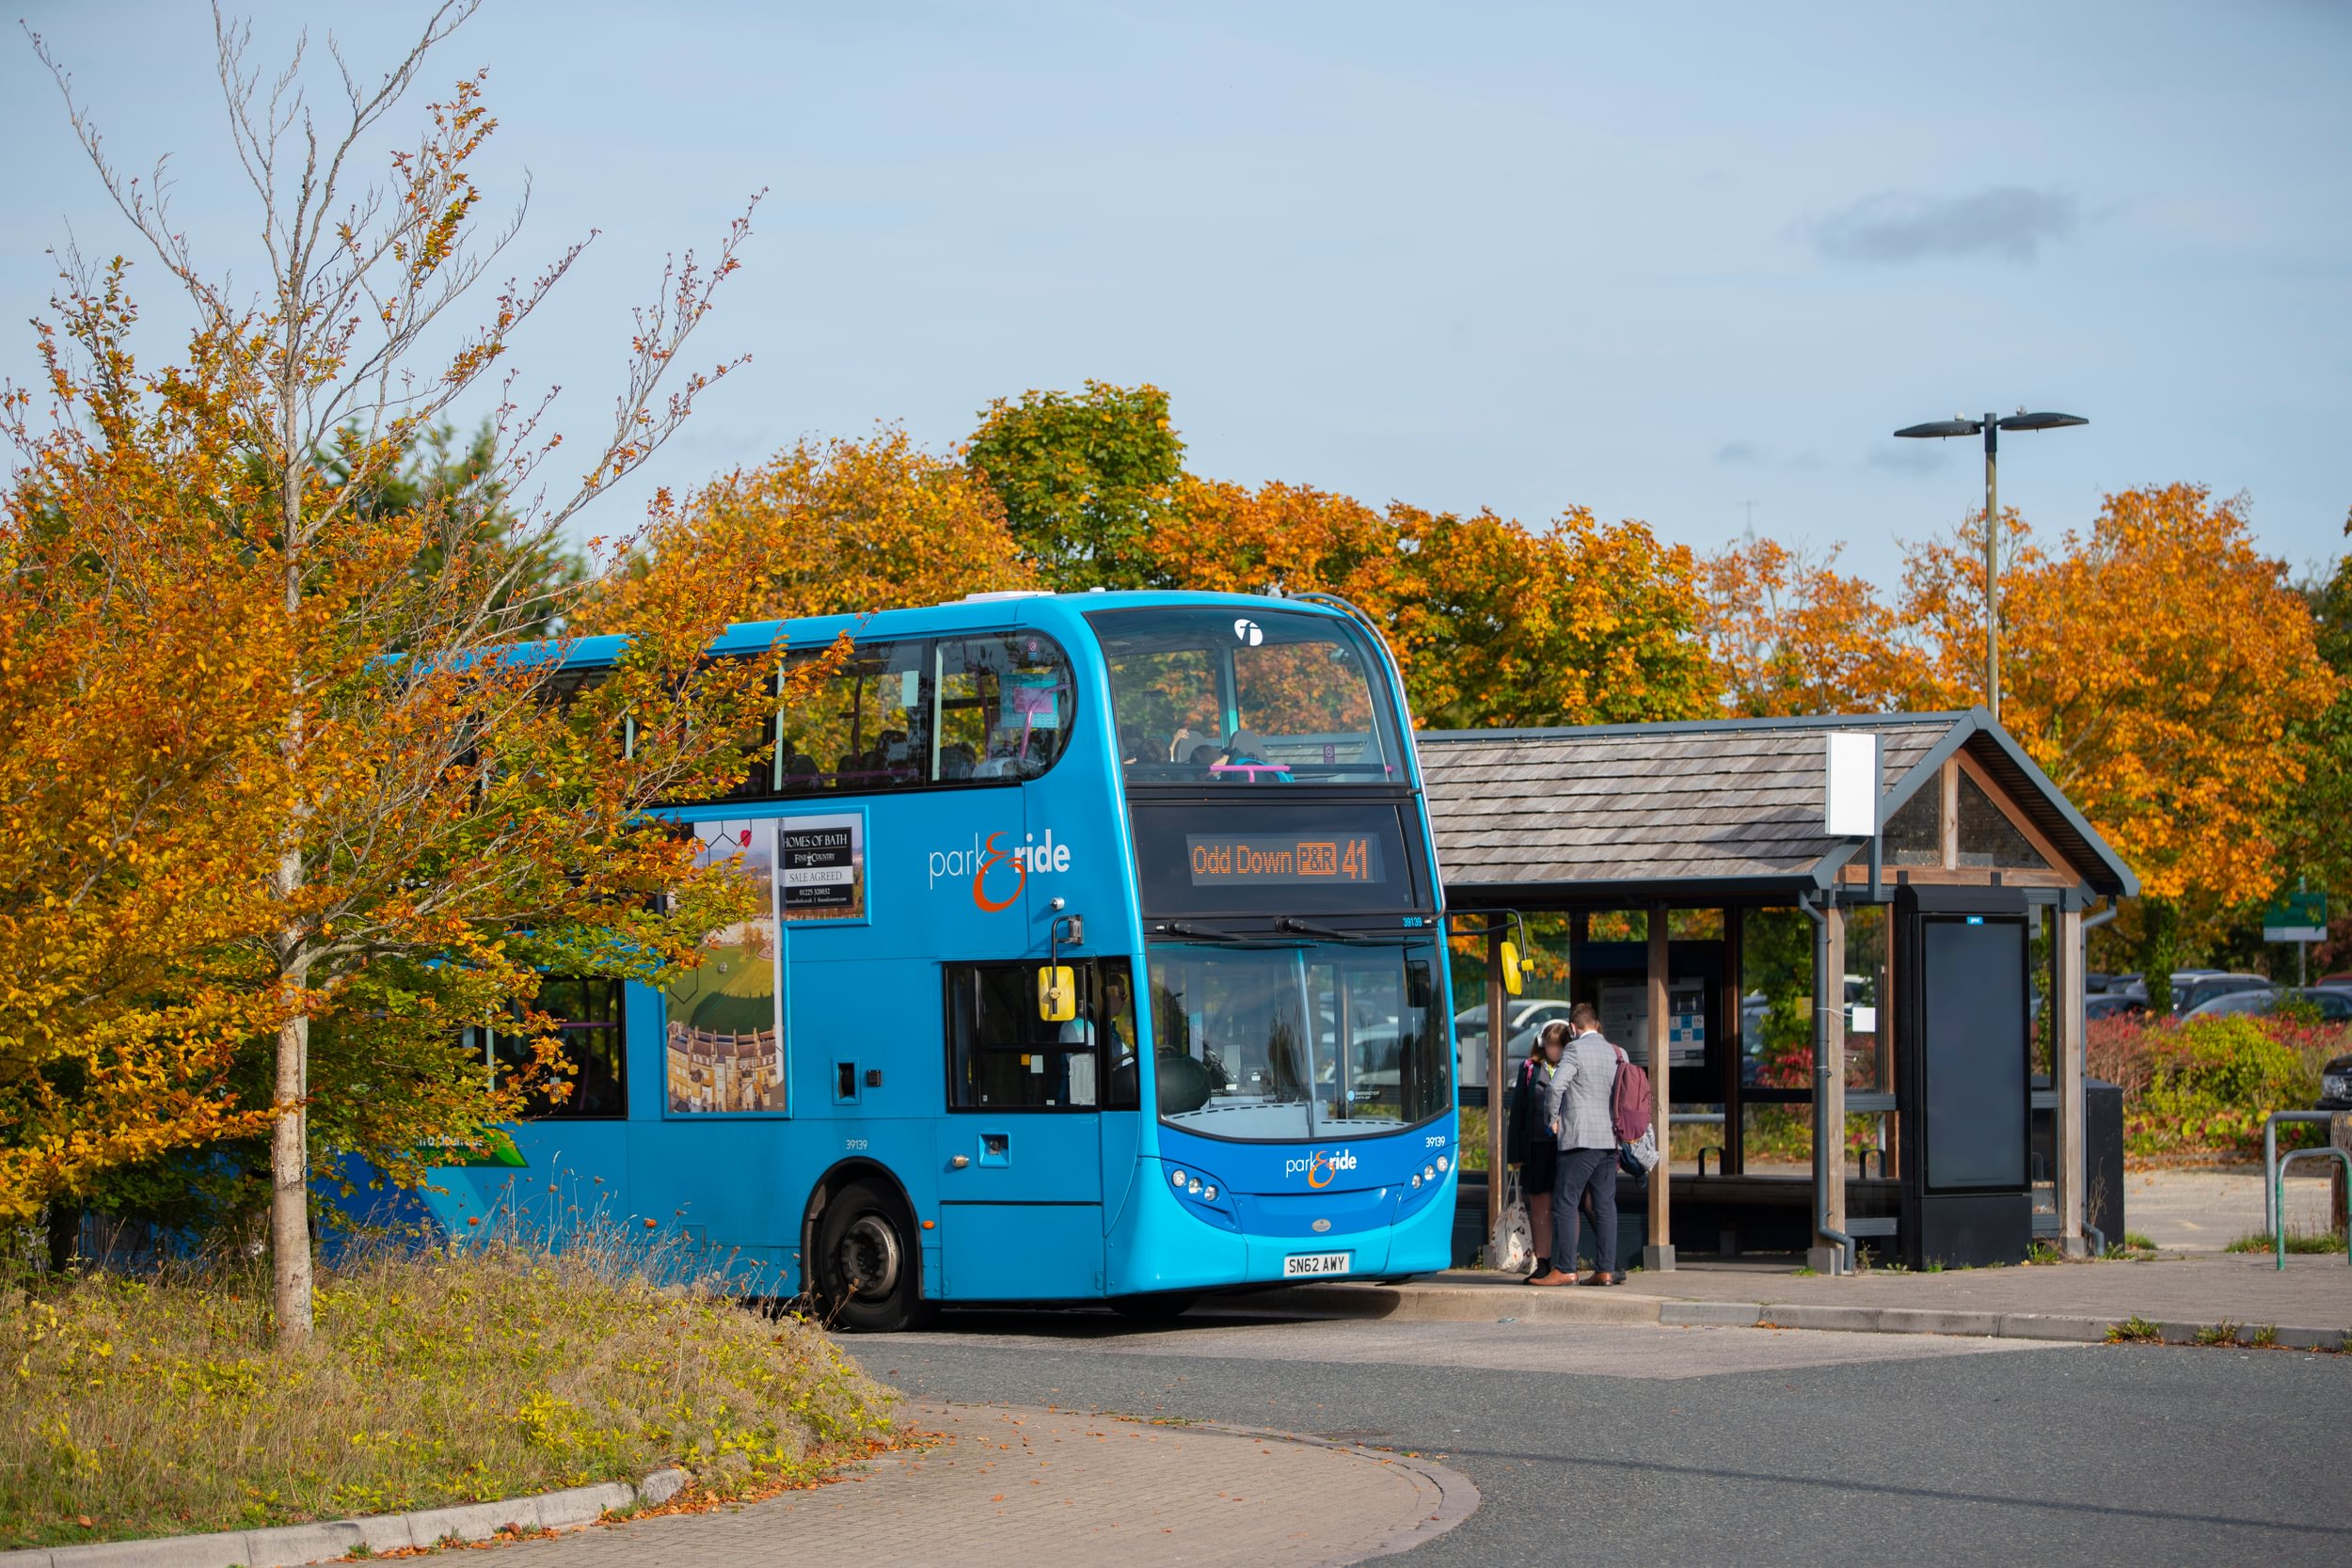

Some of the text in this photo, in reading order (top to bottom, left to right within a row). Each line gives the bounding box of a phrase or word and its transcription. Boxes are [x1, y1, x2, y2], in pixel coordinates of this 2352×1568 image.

[785, 833, 848, 847] HOMES OF BATH
[929, 832, 989, 891] park
[1013, 829, 1071, 874] ride
[1192, 840, 1368, 880] Odd Down P&R 41
[789, 871, 842, 882] SALE AGREED
[1402, 916, 1422, 927] 39139
[846, 1139, 868, 1149] 39139
[1425, 1135, 1446, 1148] 39139
[1286, 1150, 1317, 1179] park
[1328, 1148, 1357, 1170] ride
[1289, 1256, 1344, 1274] SN62 AWY
